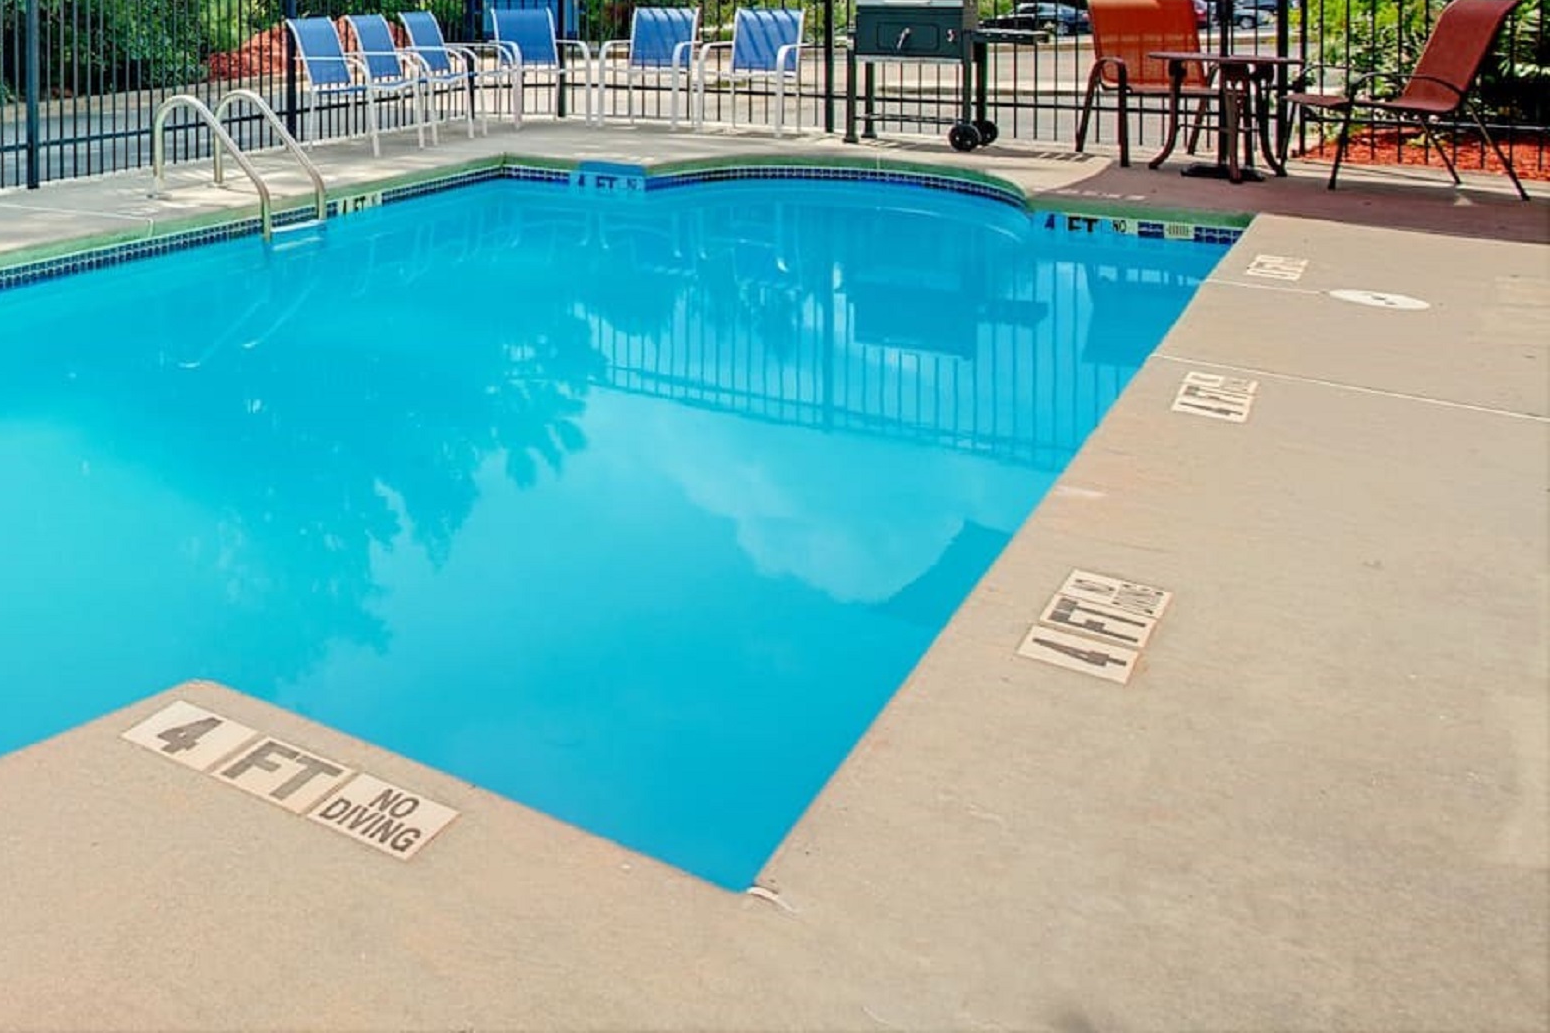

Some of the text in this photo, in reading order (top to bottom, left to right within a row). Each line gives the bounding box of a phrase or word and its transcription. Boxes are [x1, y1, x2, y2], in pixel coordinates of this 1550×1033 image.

[1068, 216, 1099, 232] FT
[1032, 597, 1146, 667] 4 FT
[156, 716, 344, 802] 4 FT
[318, 797, 421, 853] DIVING
[368, 788, 420, 818] NO
